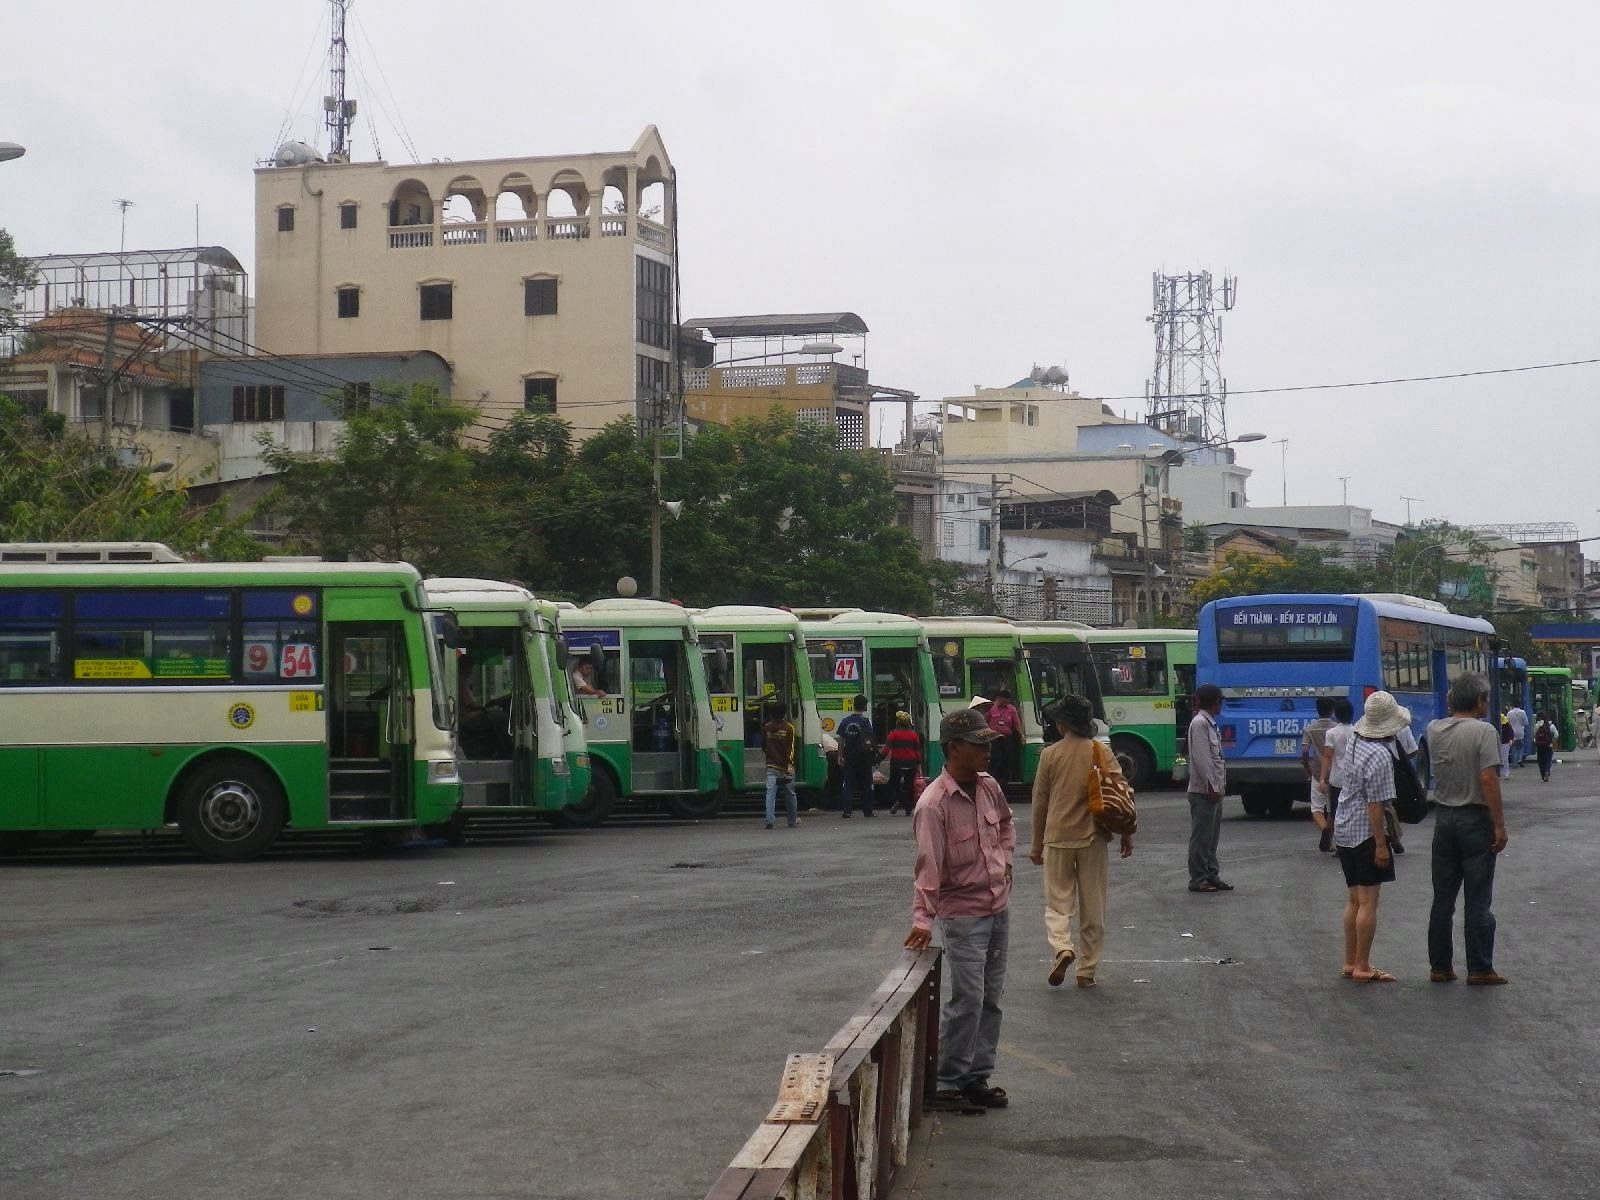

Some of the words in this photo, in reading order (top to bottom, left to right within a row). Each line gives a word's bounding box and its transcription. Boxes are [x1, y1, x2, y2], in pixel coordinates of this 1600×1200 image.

[1233, 609, 1248, 625] BẾN
[1249, 611, 1273, 625] THÀNH
[1279, 609, 1294, 624] BẾN
[1295, 613, 1306, 624] XE
[248, 644, 268, 672] 9
[283, 645, 312, 676] 54
[836, 659, 855, 679] 47
